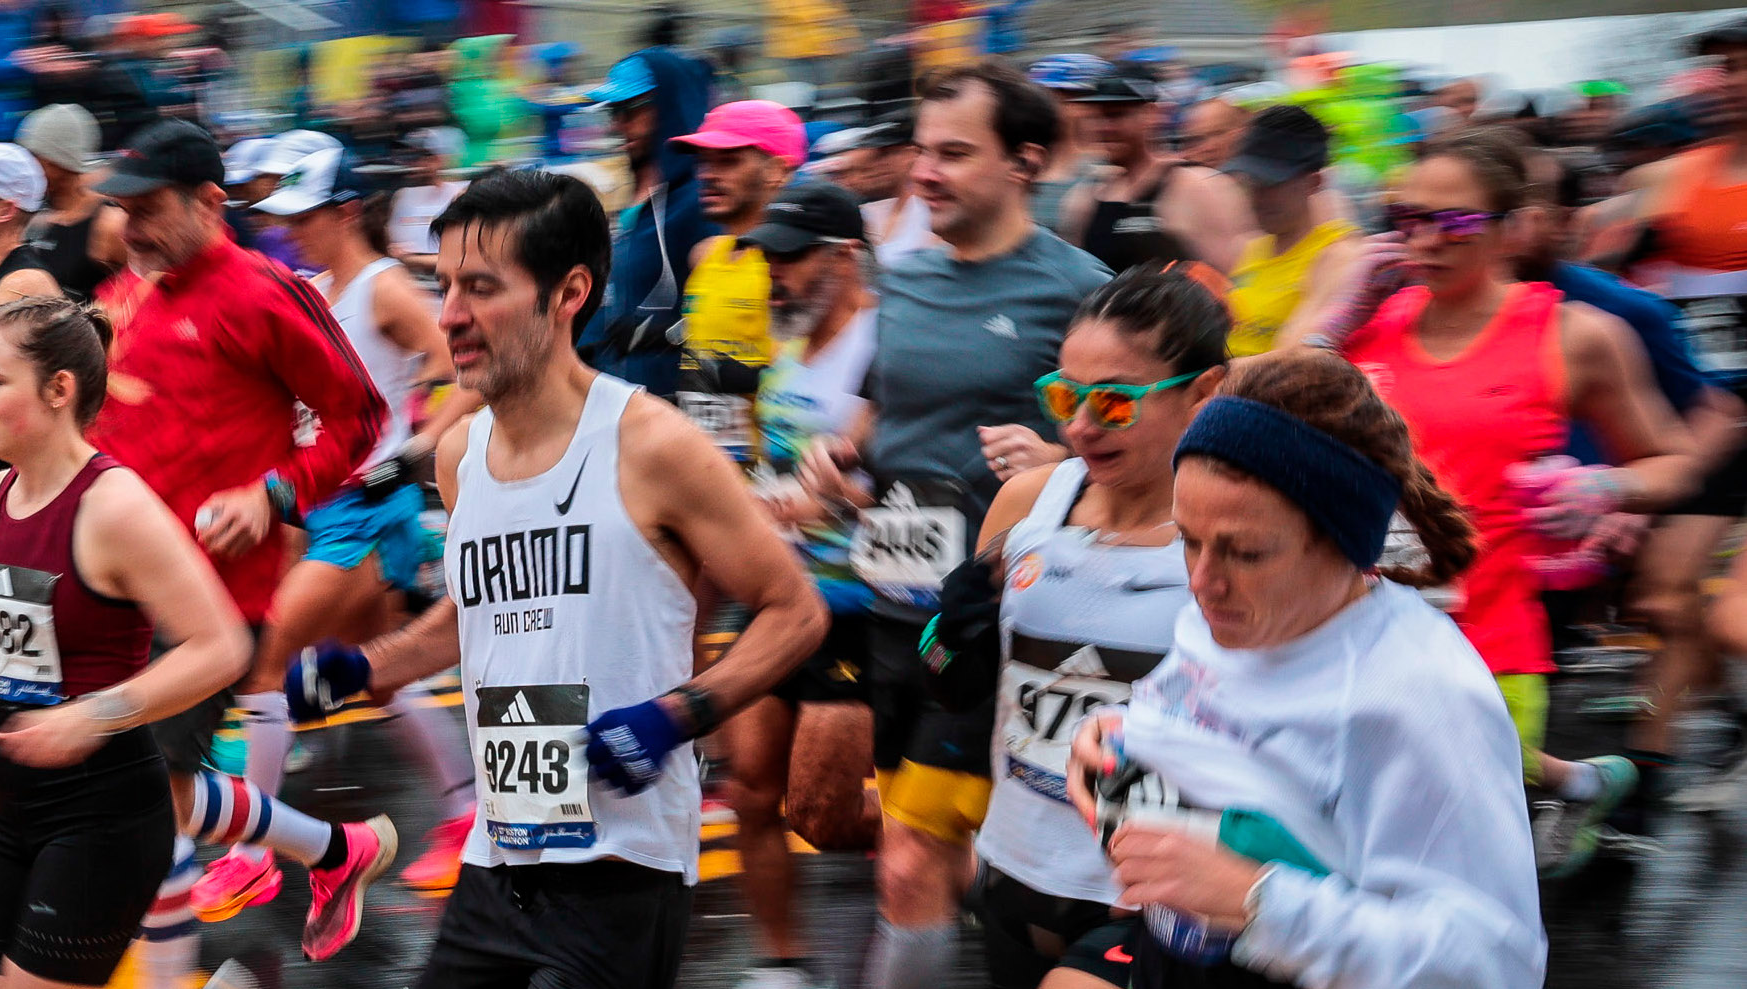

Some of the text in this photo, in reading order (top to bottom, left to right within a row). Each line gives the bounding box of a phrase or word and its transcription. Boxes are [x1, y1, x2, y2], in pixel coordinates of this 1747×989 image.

[460, 524, 591, 608] DROMO
[494, 607, 554, 636] RUN CREW
[484, 739, 570, 794] 9243
